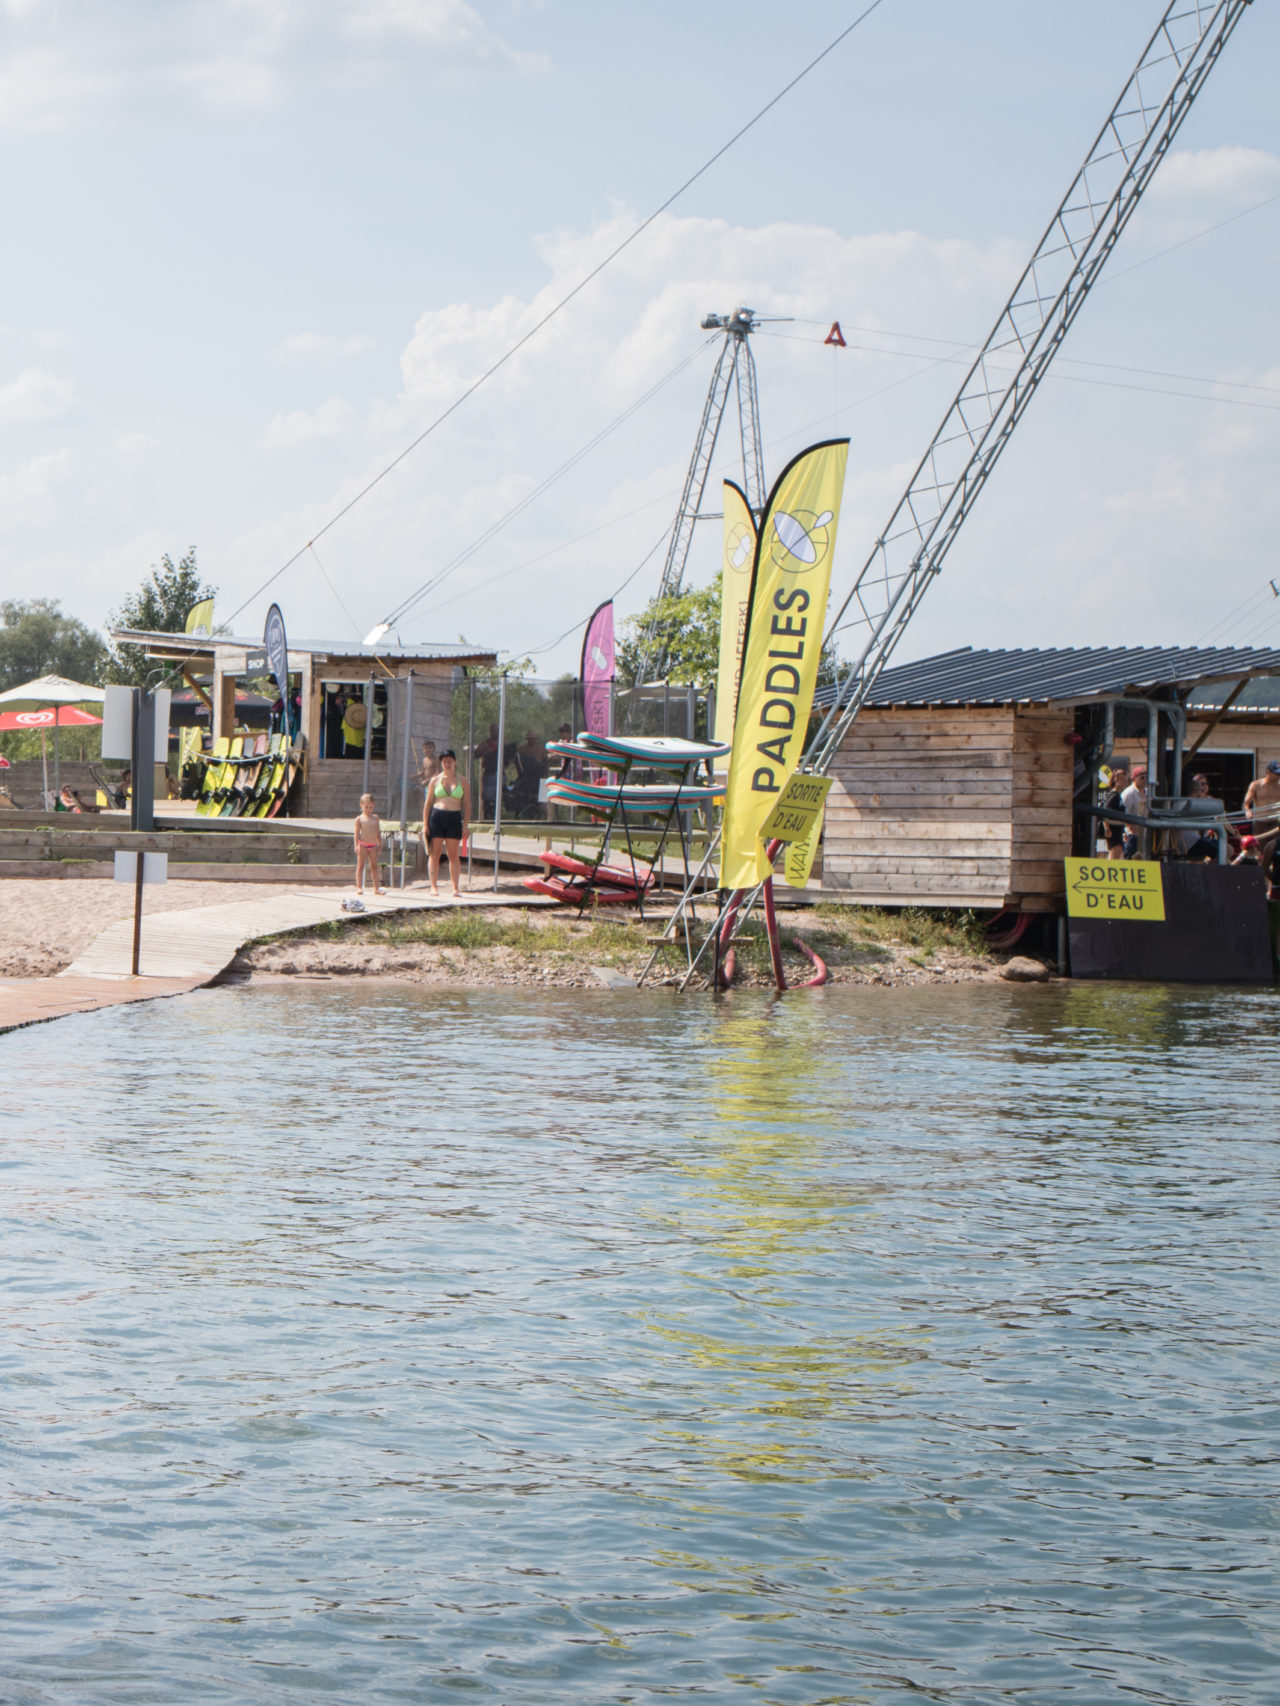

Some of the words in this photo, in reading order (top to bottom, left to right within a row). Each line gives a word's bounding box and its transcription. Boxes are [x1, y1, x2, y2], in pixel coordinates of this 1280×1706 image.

[248, 659, 265, 670] SHOP
[751, 587, 811, 793] PADDLES
[787, 782, 823, 803] SORTIE
[772, 812, 808, 832] D'EAU
[1079, 865, 1146, 884] SORTIE
[1086, 893, 1144, 911] D'EAU
